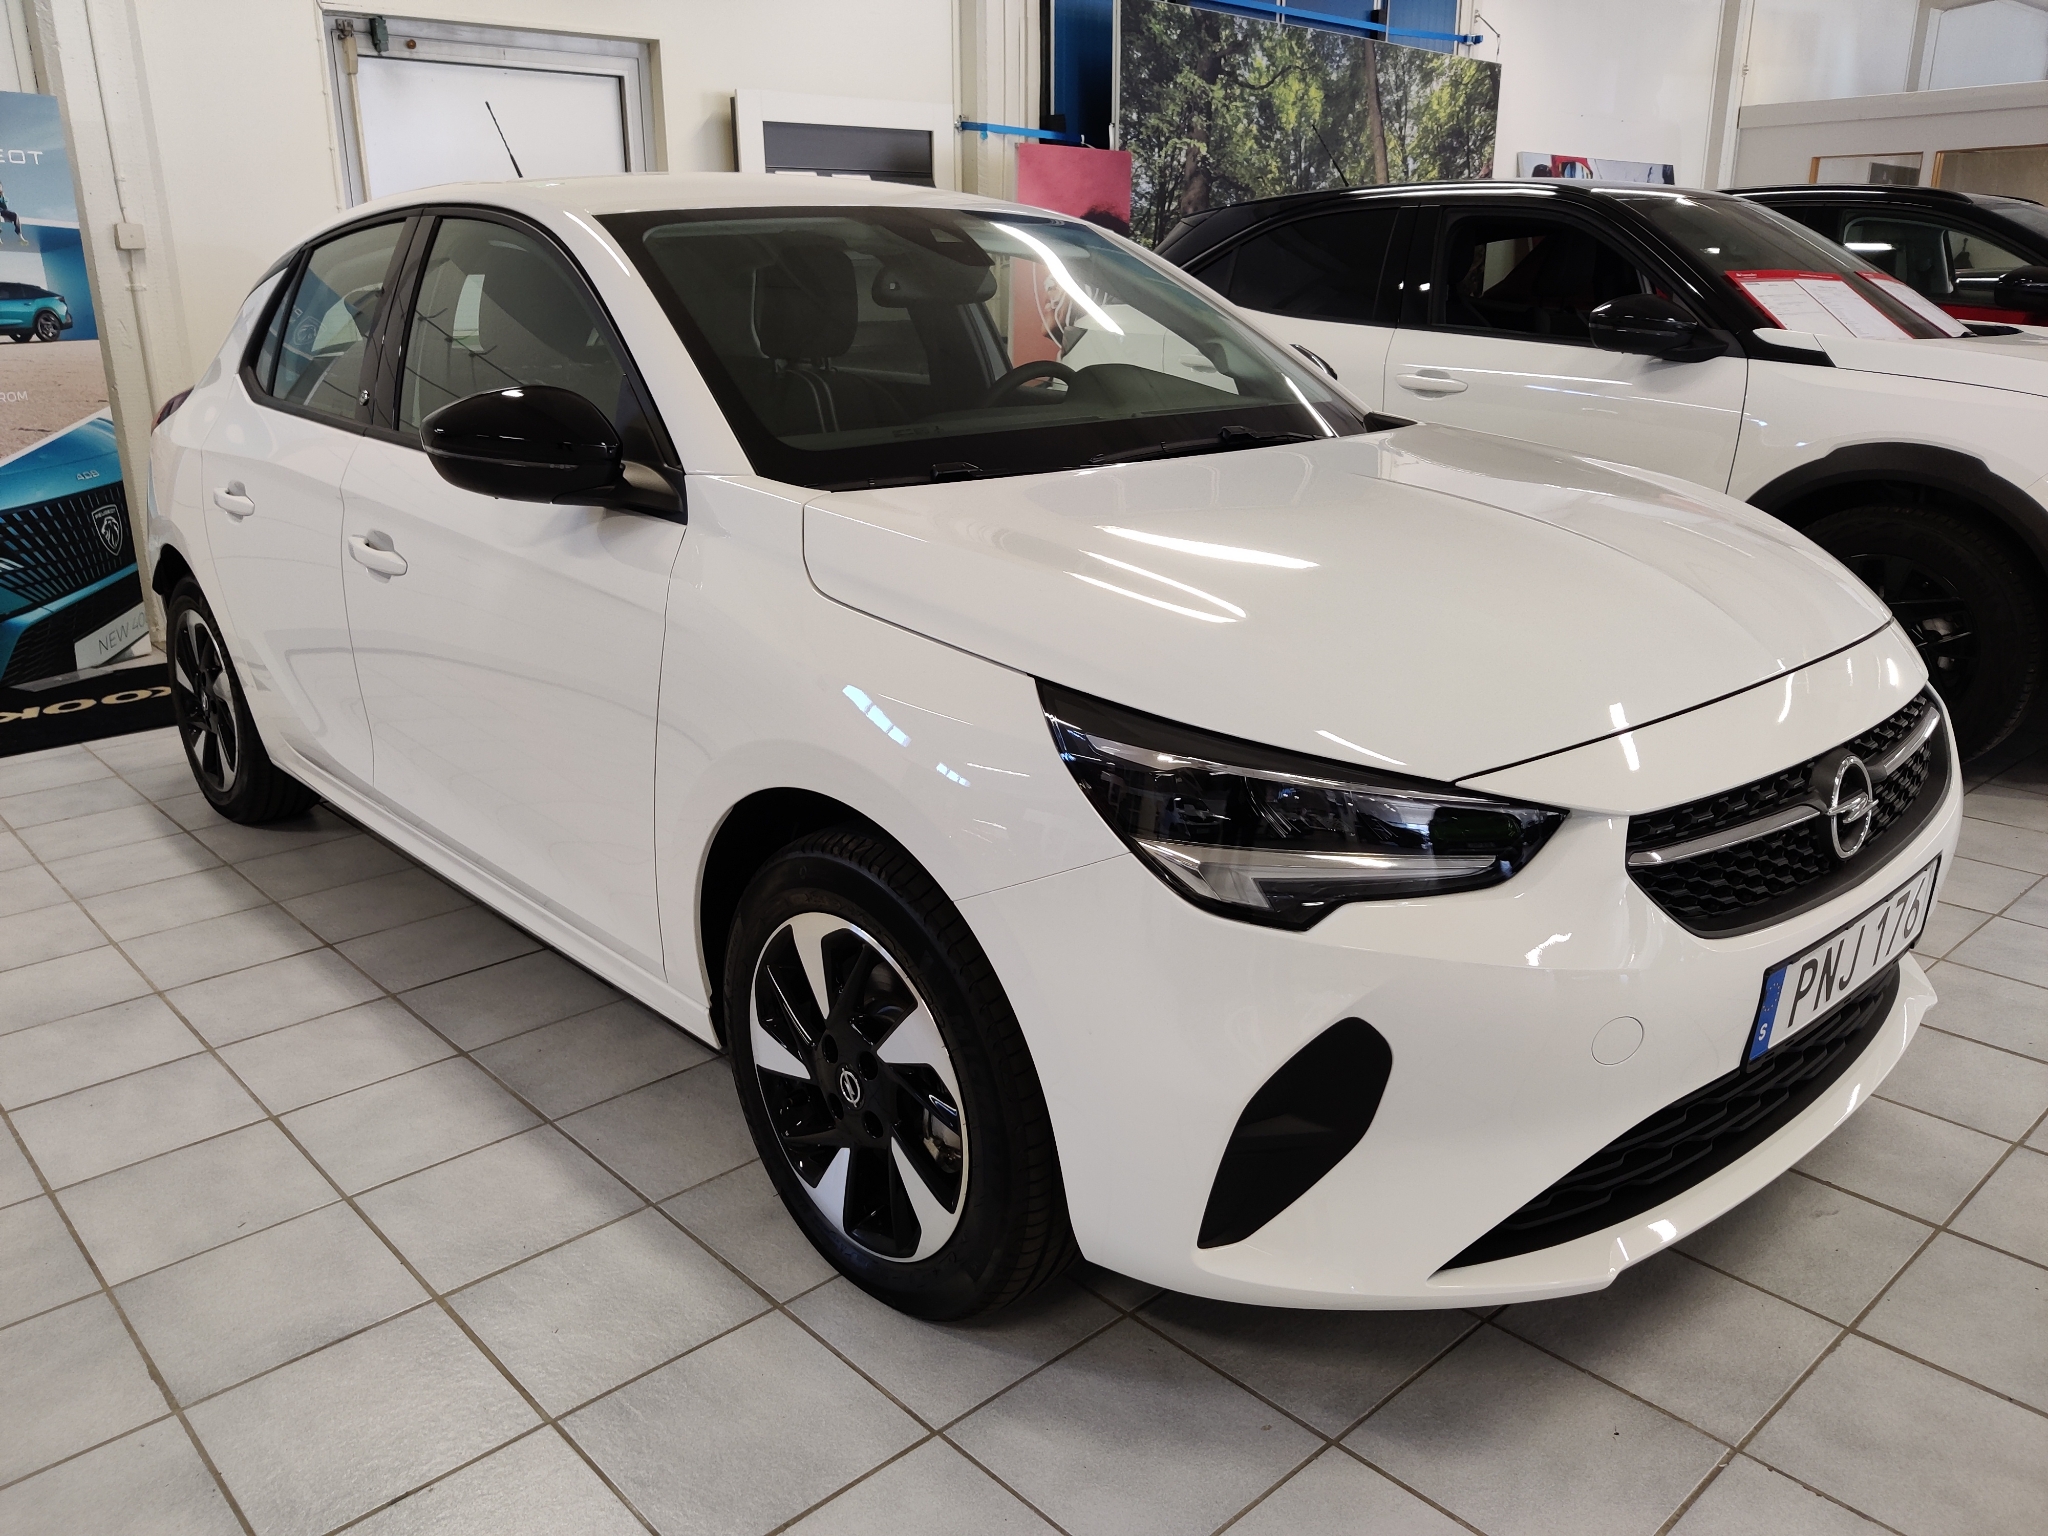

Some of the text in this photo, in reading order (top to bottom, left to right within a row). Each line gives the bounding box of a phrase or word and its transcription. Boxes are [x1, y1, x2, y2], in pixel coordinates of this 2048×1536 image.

[98, 621, 129, 655] NEW
[1787, 877, 1926, 1028] PNJ 176
[1758, 1022, 1768, 1041] S
